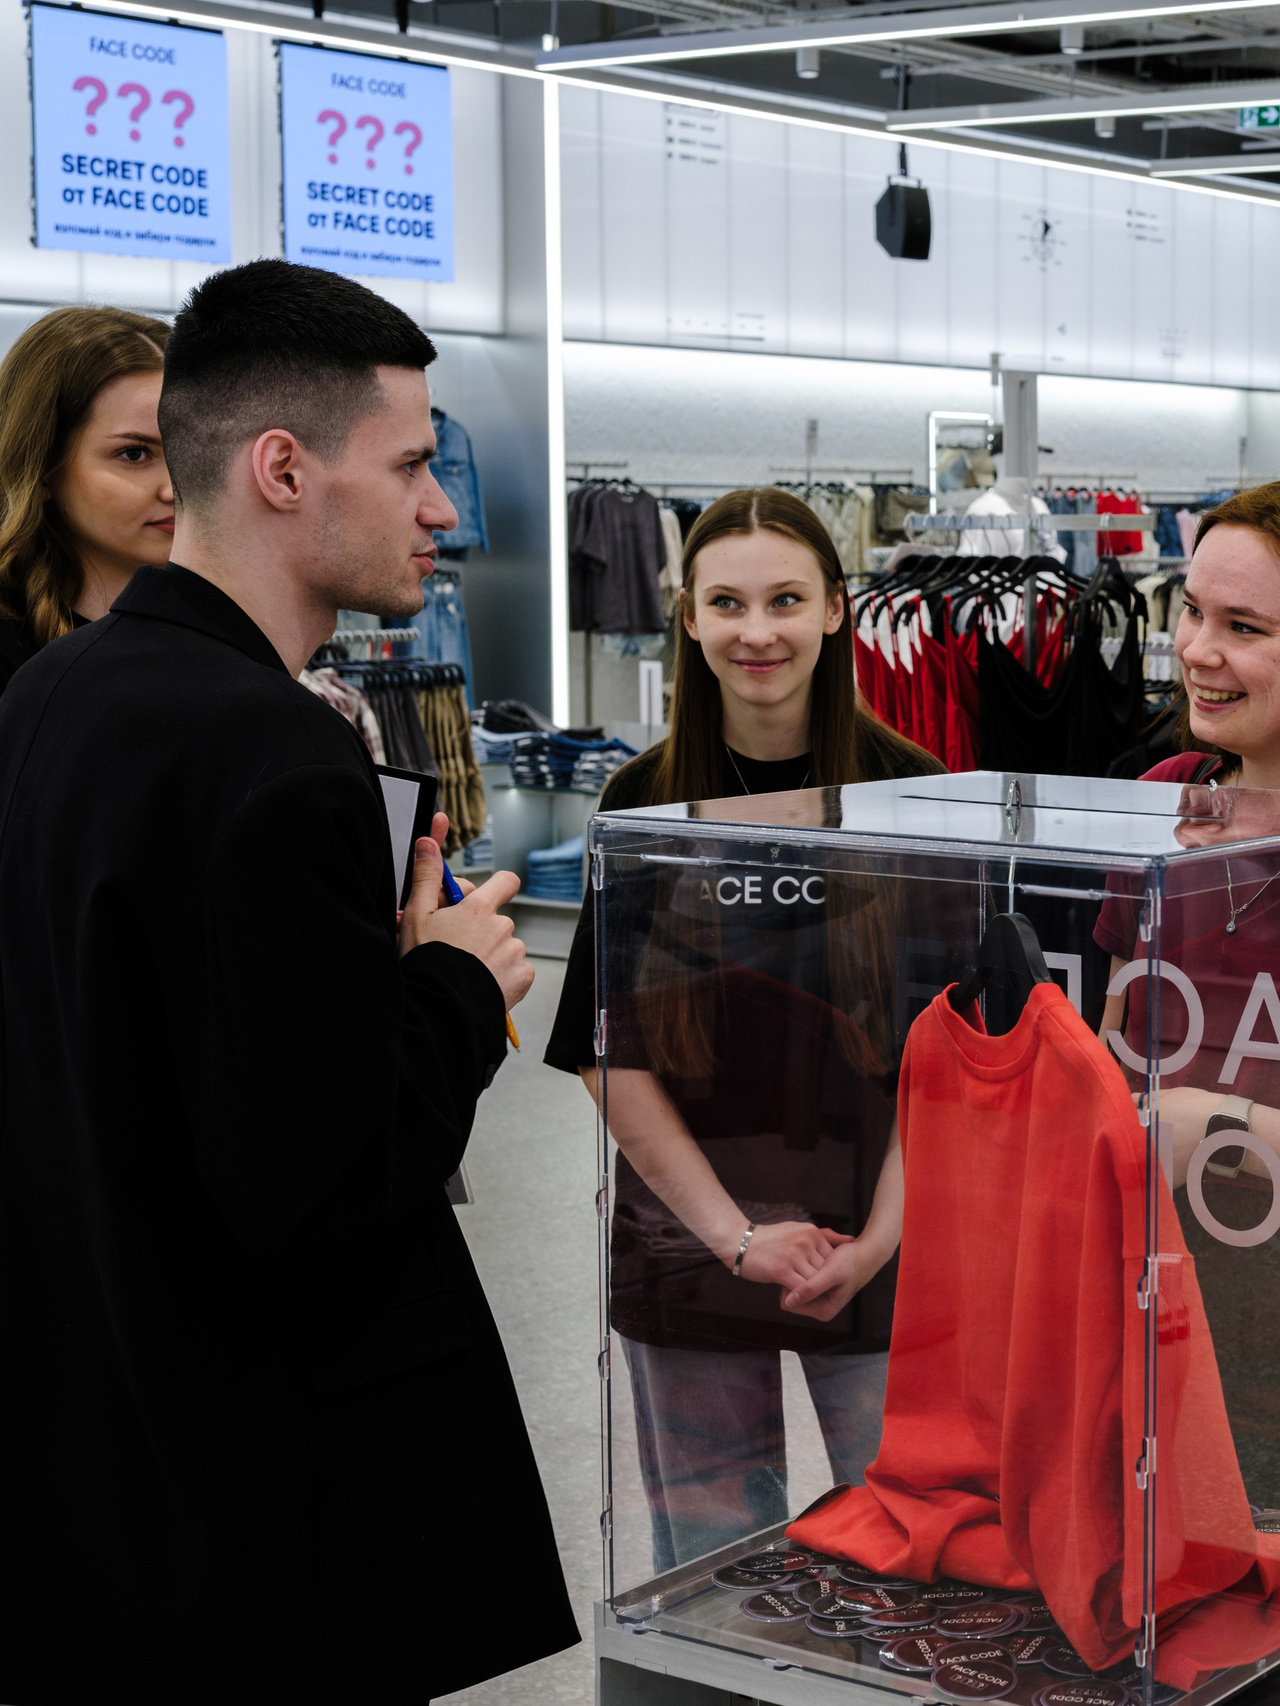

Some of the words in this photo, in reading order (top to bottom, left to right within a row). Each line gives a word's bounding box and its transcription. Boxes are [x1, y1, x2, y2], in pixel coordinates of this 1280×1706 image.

[90, 37, 128, 58] FACE
[132, 43, 176, 65] CODE
[331, 72, 364, 93] FACE
[367, 78, 407, 98] CODE
[62, 153, 145, 180] SECRET
[151, 164, 208, 188] CODE
[63, 188, 84, 204] от
[92, 186, 145, 210] FACE
[152, 193, 209, 217] CODE
[307, 181, 379, 206] SECRET
[384, 190, 434, 213] CODE
[308, 213, 327, 229] от
[334, 211, 379, 233] FACE
[385, 217, 434, 239] CODE
[701, 876, 762, 905] ACE
[772, 875, 826, 905] CO
[873, 1628, 905, 1636] CODE
[939, 1653, 969, 1665] FACE
[970, 1650, 1004, 1660] CODE
[951, 1664, 977, 1676] FACE
[978, 1672, 1009, 1687] CODE
[1050, 1694, 1085, 1704] CODE
[1086, 1696, 1115, 1706] FACE
